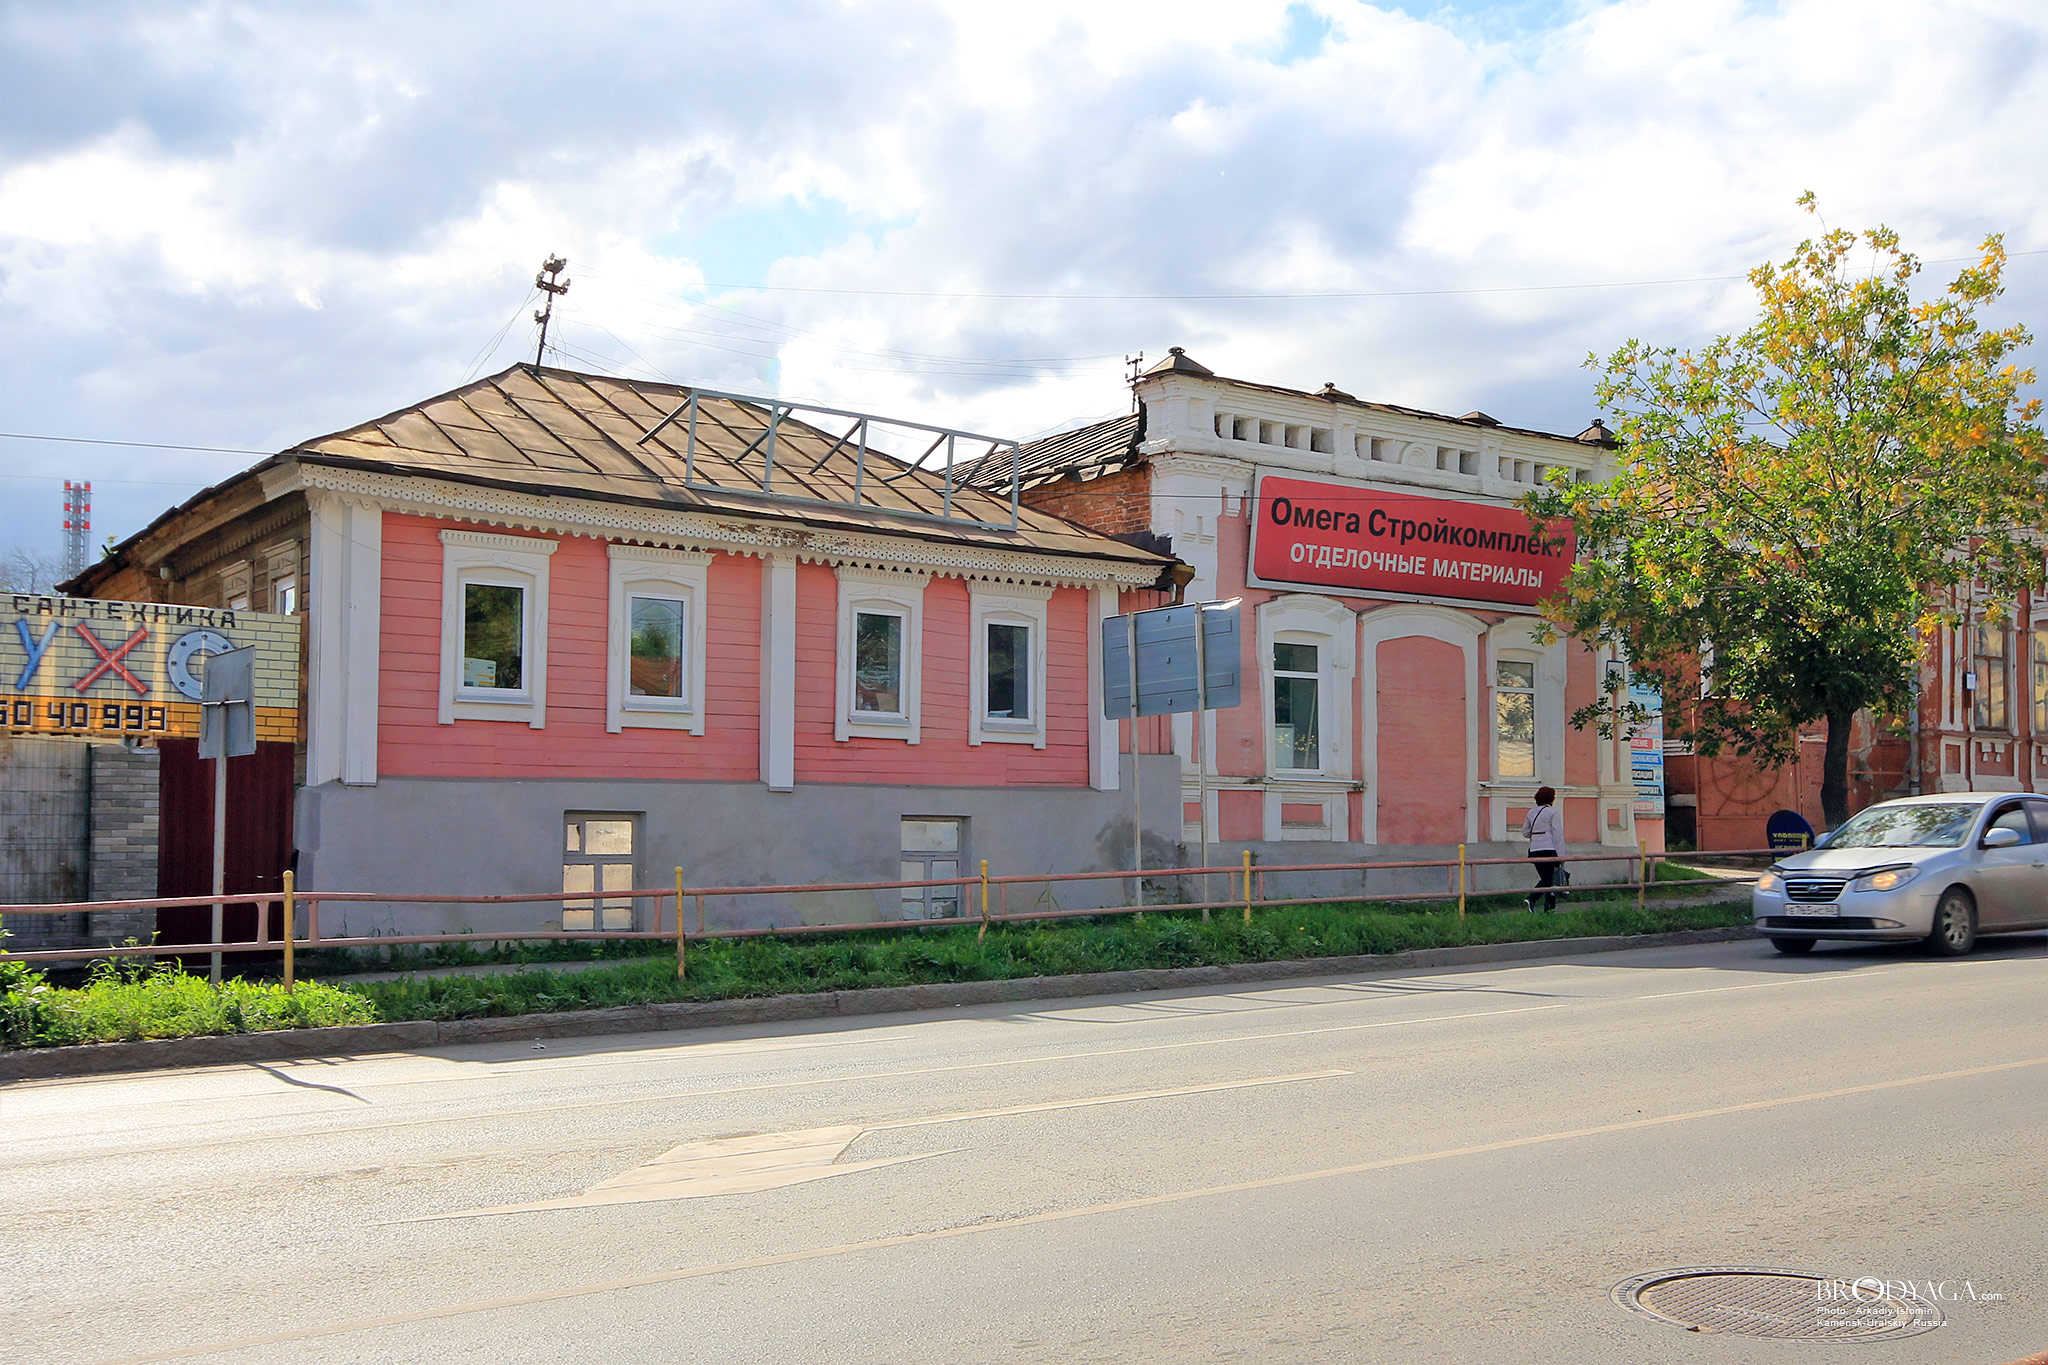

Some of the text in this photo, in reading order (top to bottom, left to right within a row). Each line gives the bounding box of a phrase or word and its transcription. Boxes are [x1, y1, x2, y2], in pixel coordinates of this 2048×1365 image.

[1270, 496, 1360, 534] Омега
[1290, 542, 1543, 588] ОТДЕЛОЧНЫЕ МАТЕРИАЛЫ
[12, 595, 237, 629] САНТЕХНИКА
[48, 701, 90, 729] 40
[103, 703, 167, 732] 999
